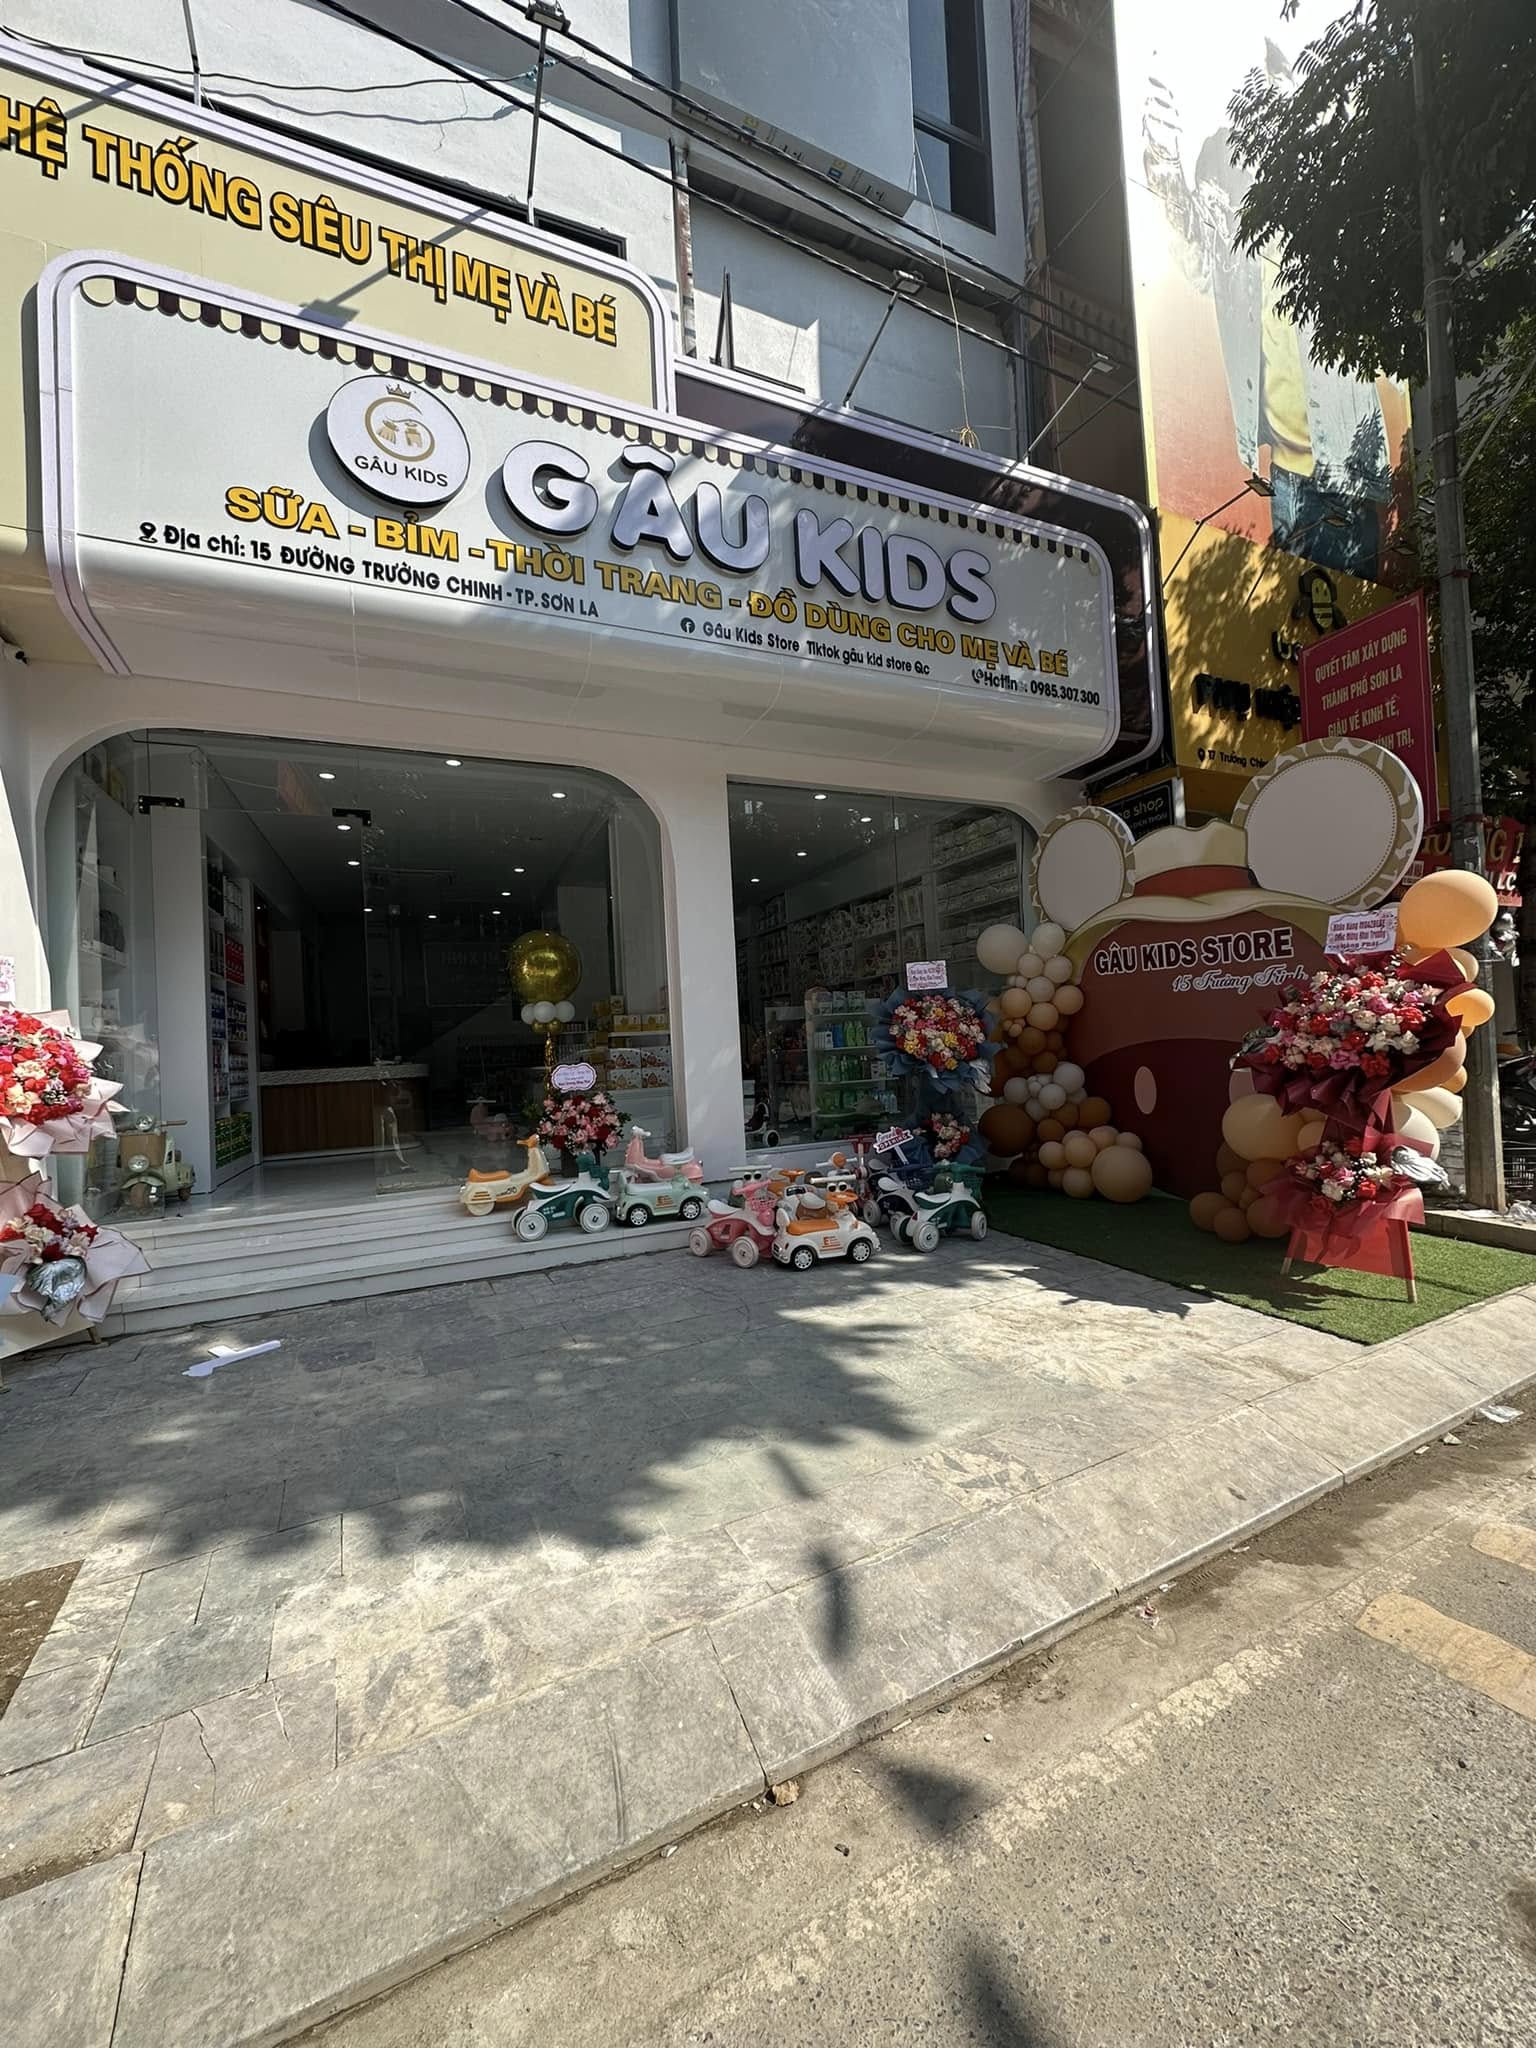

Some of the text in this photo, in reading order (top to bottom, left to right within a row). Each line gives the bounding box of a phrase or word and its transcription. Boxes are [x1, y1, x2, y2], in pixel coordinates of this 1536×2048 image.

[0, 95, 617, 347] HỆ THỐNG SIÊU THỊ MẸ VÀ BÉ
[355, 455, 448, 487] GÂU KIDS
[503, 440, 996, 624] GÂU KIDS
[164, 525, 200, 550] Địa
[207, 535, 245, 557] chỉ:
[250, 540, 271, 561] 15
[280, 545, 355, 575] ĐƯỜNG
[362, 560, 440, 589] TRƯỜNG
[446, 576, 502, 601] CHINH
[541, 592, 574, 613] SƠN
[579, 600, 599, 617] LA
[225, 486, 340, 539] SỮA
[375, 511, 459, 562] BỈM
[485, 538, 585, 585] THỜI
[593, 560, 722, 609] TRANG
[748, 587, 797, 623] ĐỒ
[805, 601, 891, 643] DÙNG
[897, 622, 955, 654] CHO
[961, 634, 999, 669] MẸ
[1002, 640, 1035, 670] VÀ
[1039, 649, 1068, 677] BÉ
[703, 621, 731, 640] Gâu
[735, 627, 763, 645] Kids
[767, 633, 800, 652] Store
[806, 640, 840, 660] Tiktok
[843, 647, 864, 664] gâu
[867, 651, 883, 667] kid
[886, 656, 912, 672] store
[1314, 628, 1407, 684] QUYẾT TÂM XÂY DỰNG
[1030, 680, 1100, 705] 0985.307.300
[1321, 686, 1349, 711] THÀNH
[1350, 672, 1368, 699] PHỐ
[1370, 669, 1388, 691] SƠN
[1391, 663, 1402, 683] LA
[1362, 704, 1383, 727] KINH
[1094, 927, 1294, 975] GÂU KIDS STORE
[1173, 973, 1192, 992] 15
